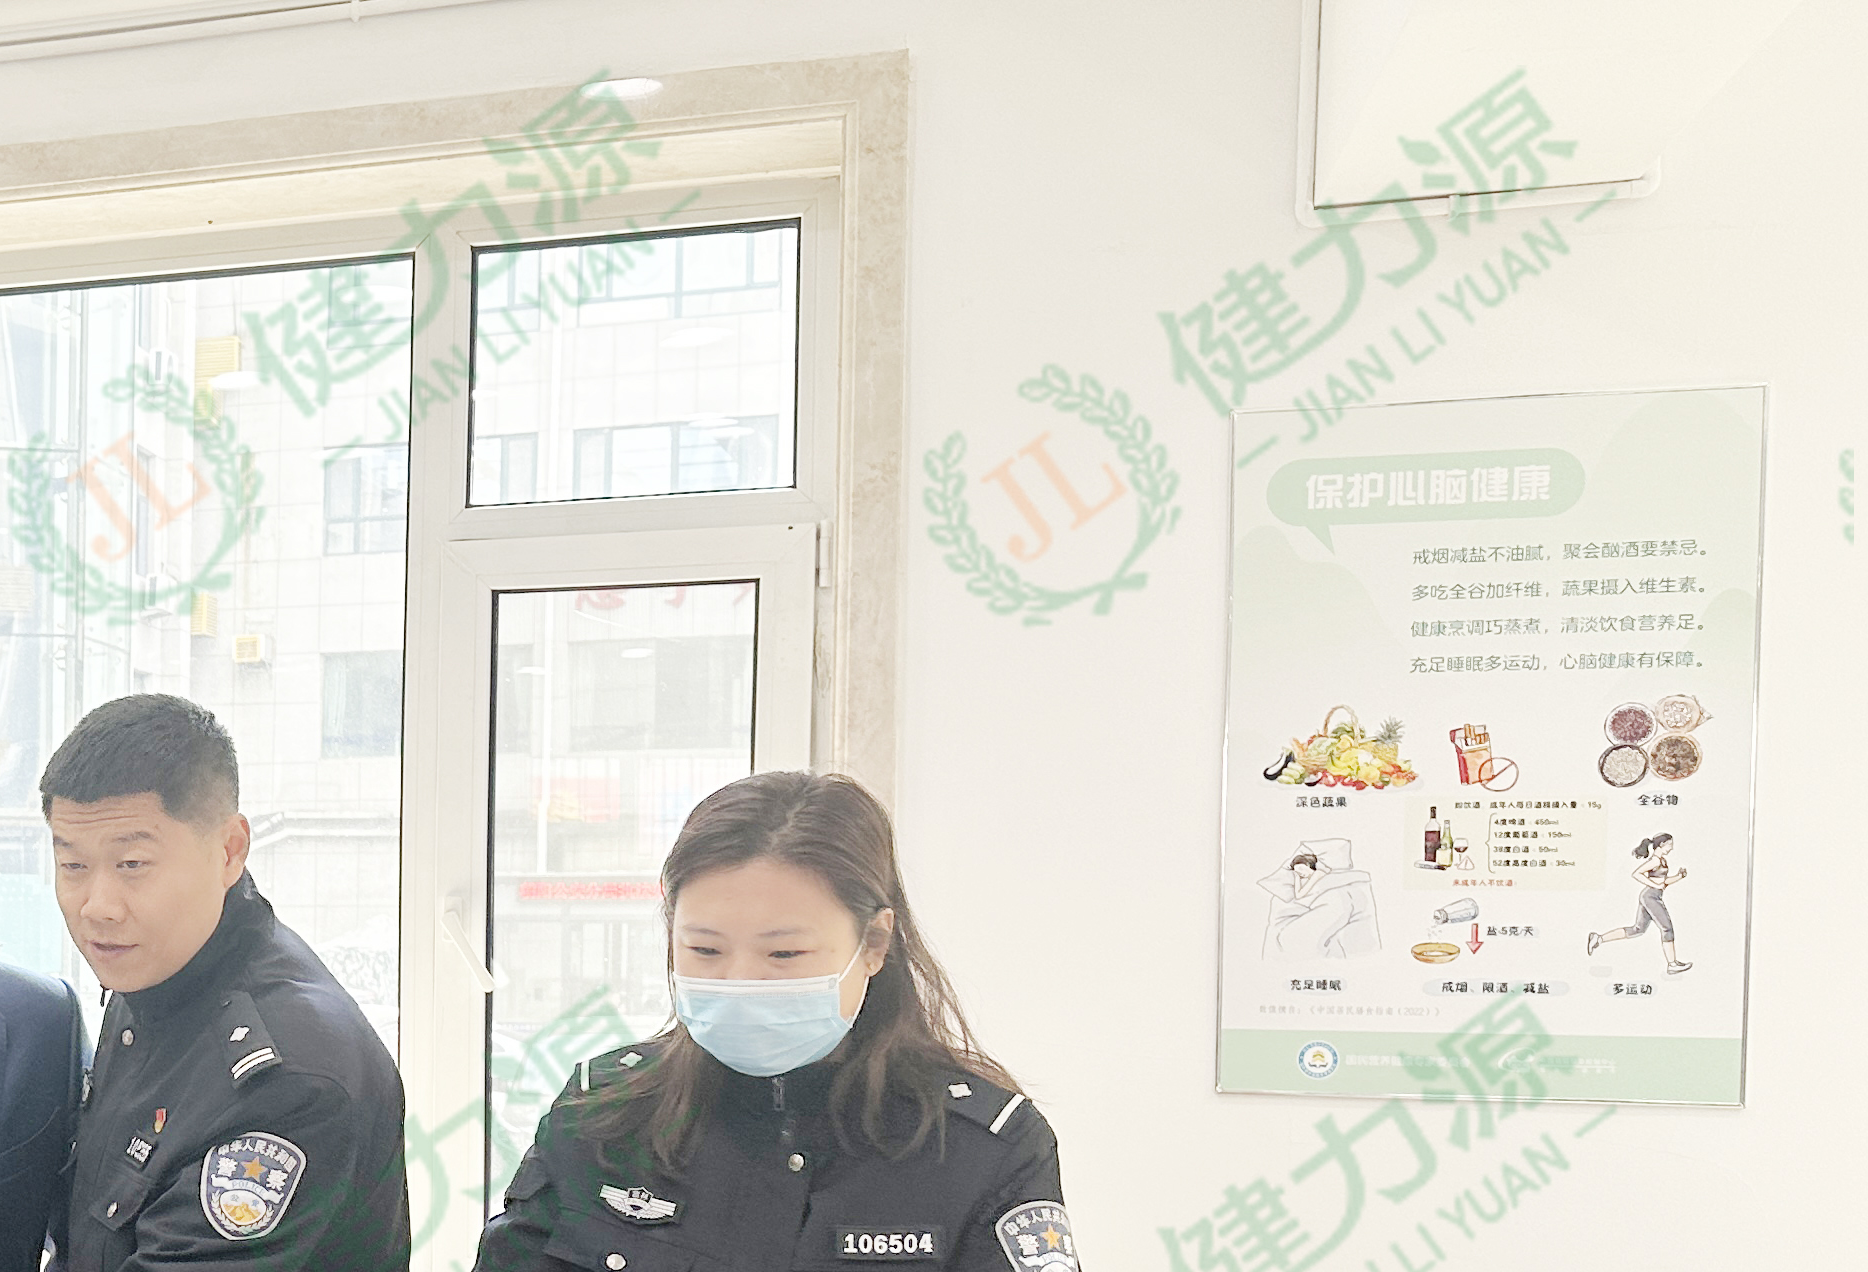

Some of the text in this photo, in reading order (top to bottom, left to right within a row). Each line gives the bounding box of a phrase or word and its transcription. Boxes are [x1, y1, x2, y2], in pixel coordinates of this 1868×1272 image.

[1306, 464, 1551, 509] 保护心脑健康
[1295, 796, 1348, 808] 深色蔬果
[1637, 794, 1679, 806] 全谷物
[1290, 979, 1342, 991] 充足睡眠
[1612, 983, 1652, 995] 多运动
[217, 1138, 298, 1173] 中华人民共和国
[231, 1180, 266, 1198] POLICE
[843, 1233, 934, 1254] 106504
